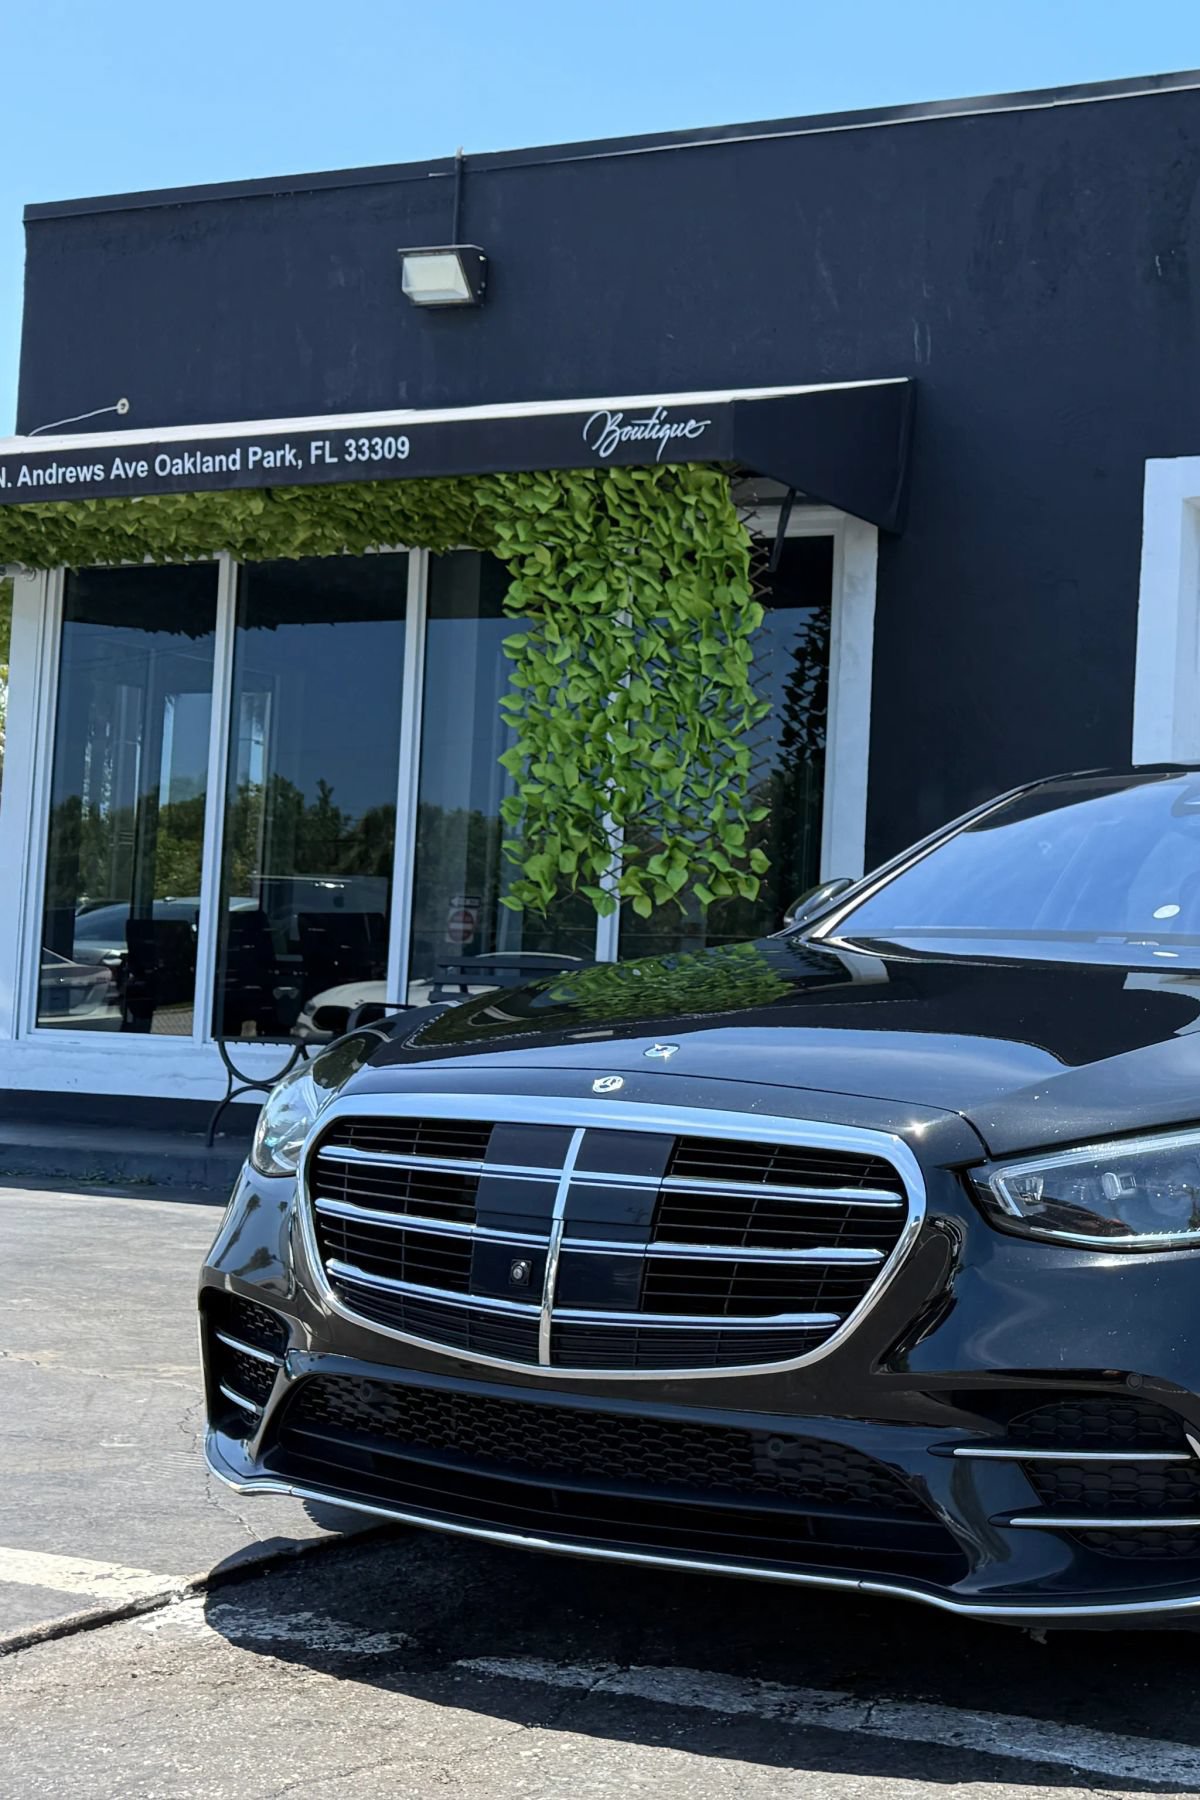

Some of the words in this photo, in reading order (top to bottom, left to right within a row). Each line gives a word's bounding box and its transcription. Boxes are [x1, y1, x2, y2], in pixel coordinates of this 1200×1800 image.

[583, 405, 712, 463] Boutique
[17, 462, 105, 487] Andrews
[109, 457, 149, 480] Ave
[154, 448, 241, 477] Oakland
[248, 444, 303, 470] Park,
[310, 440, 339, 465] FL
[344, 436, 410, 462] 33309
